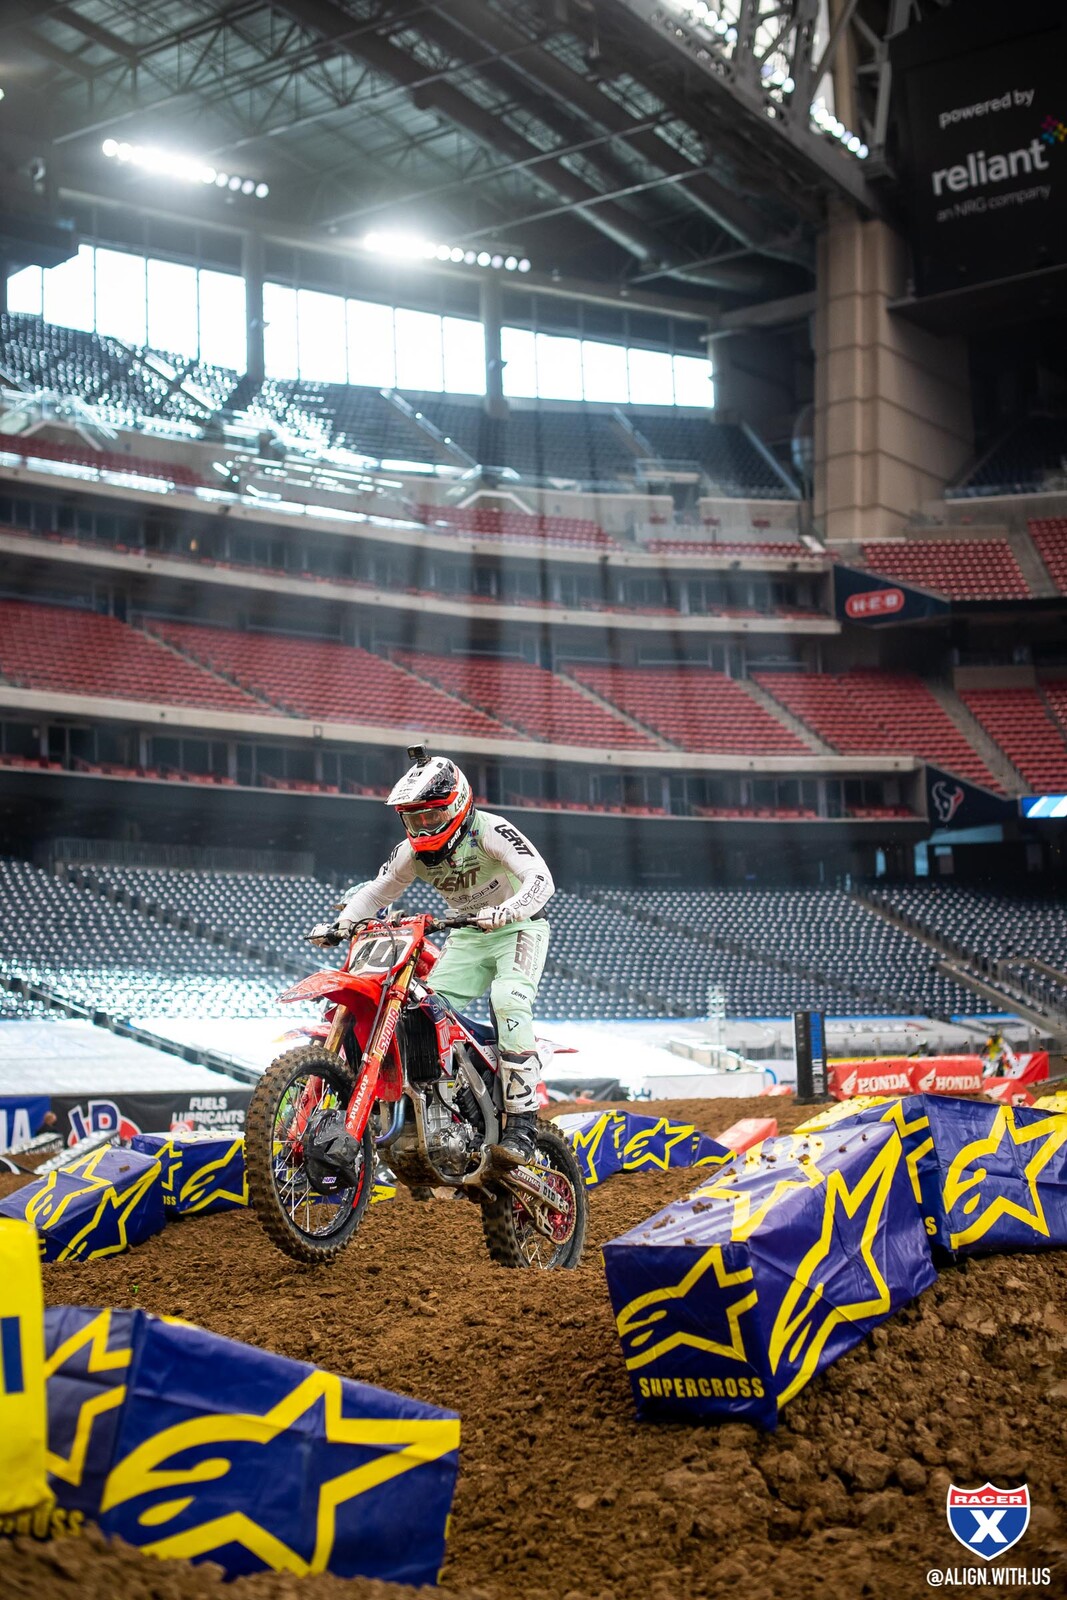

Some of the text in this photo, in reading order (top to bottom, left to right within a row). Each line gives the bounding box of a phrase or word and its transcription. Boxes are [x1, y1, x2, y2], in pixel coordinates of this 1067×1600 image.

[938, 88, 1035, 130] powered by
[932, 138, 1049, 196] reliant
[988, 184, 1051, 209] company
[494, 824, 535, 857] LEATT
[378, 1006, 400, 1055] SHOWA
[857, 1072, 911, 1094] HONDA
[935, 1074, 981, 1091] HONDA
[189, 1096, 228, 1110] FUELS
[349, 1074, 369, 1120] DUNLOP
[171, 1110, 245, 1124] LUBRICANTS
[638, 1376, 765, 1399] SUPERCROSS
